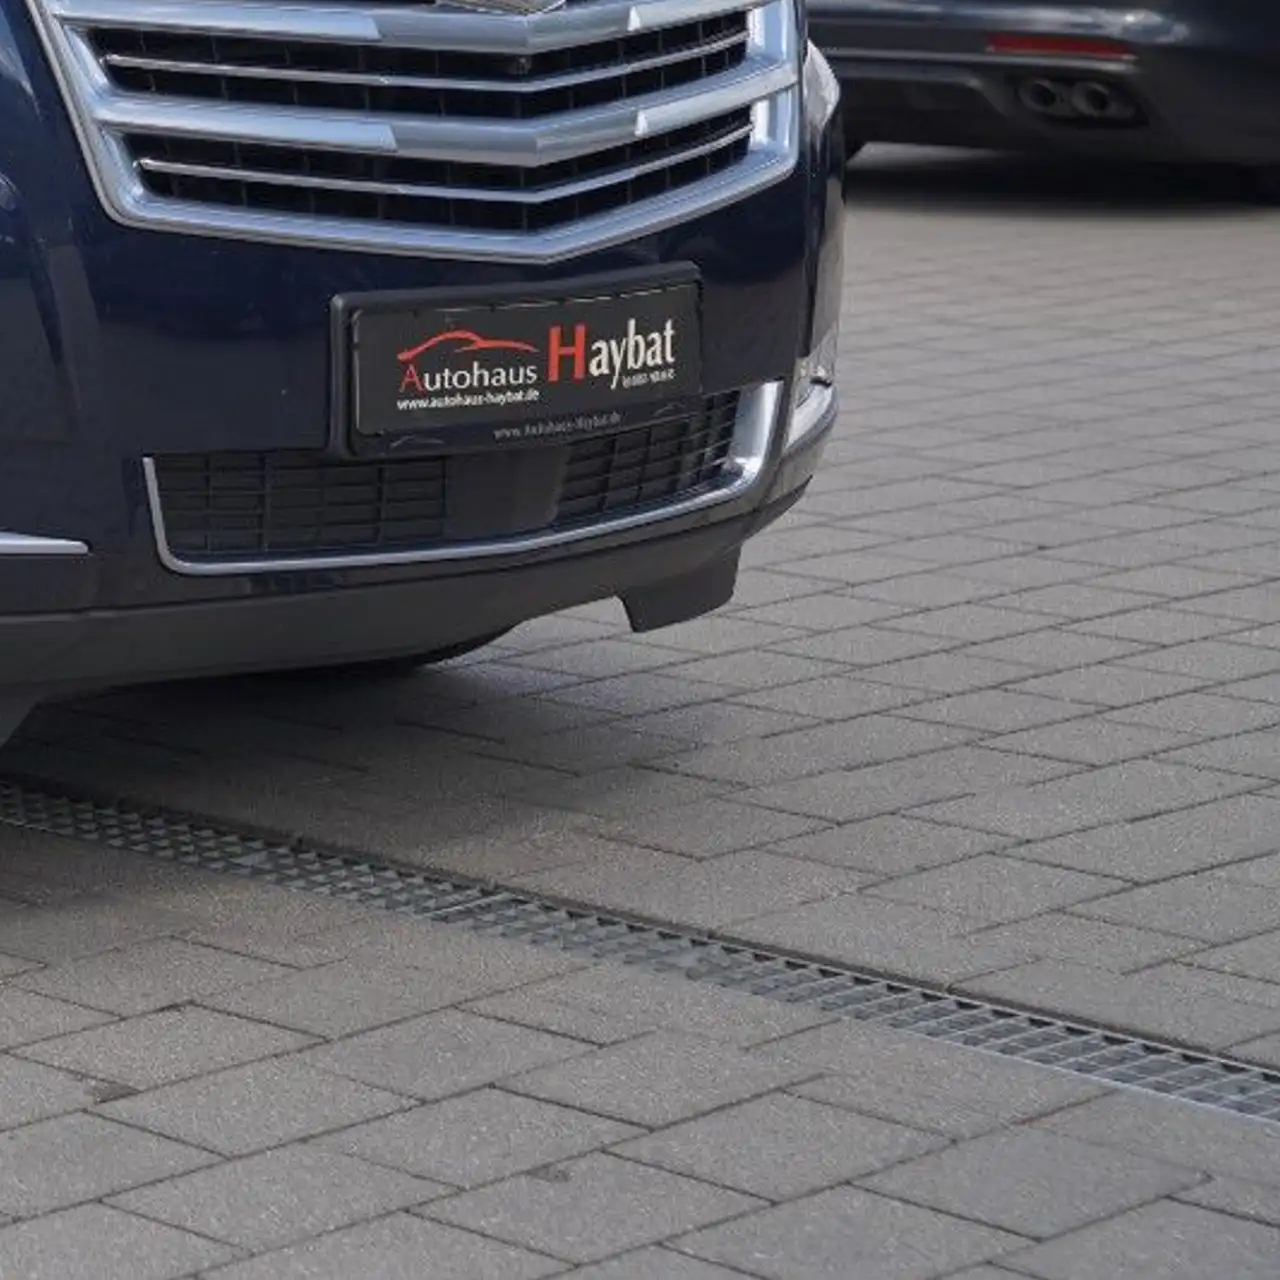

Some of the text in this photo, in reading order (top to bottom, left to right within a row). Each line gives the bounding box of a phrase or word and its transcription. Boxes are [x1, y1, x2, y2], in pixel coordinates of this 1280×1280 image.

[399, 318, 677, 394] Autohaus Haybat
[396, 388, 540, 411] www.autohaus-haybat.de
